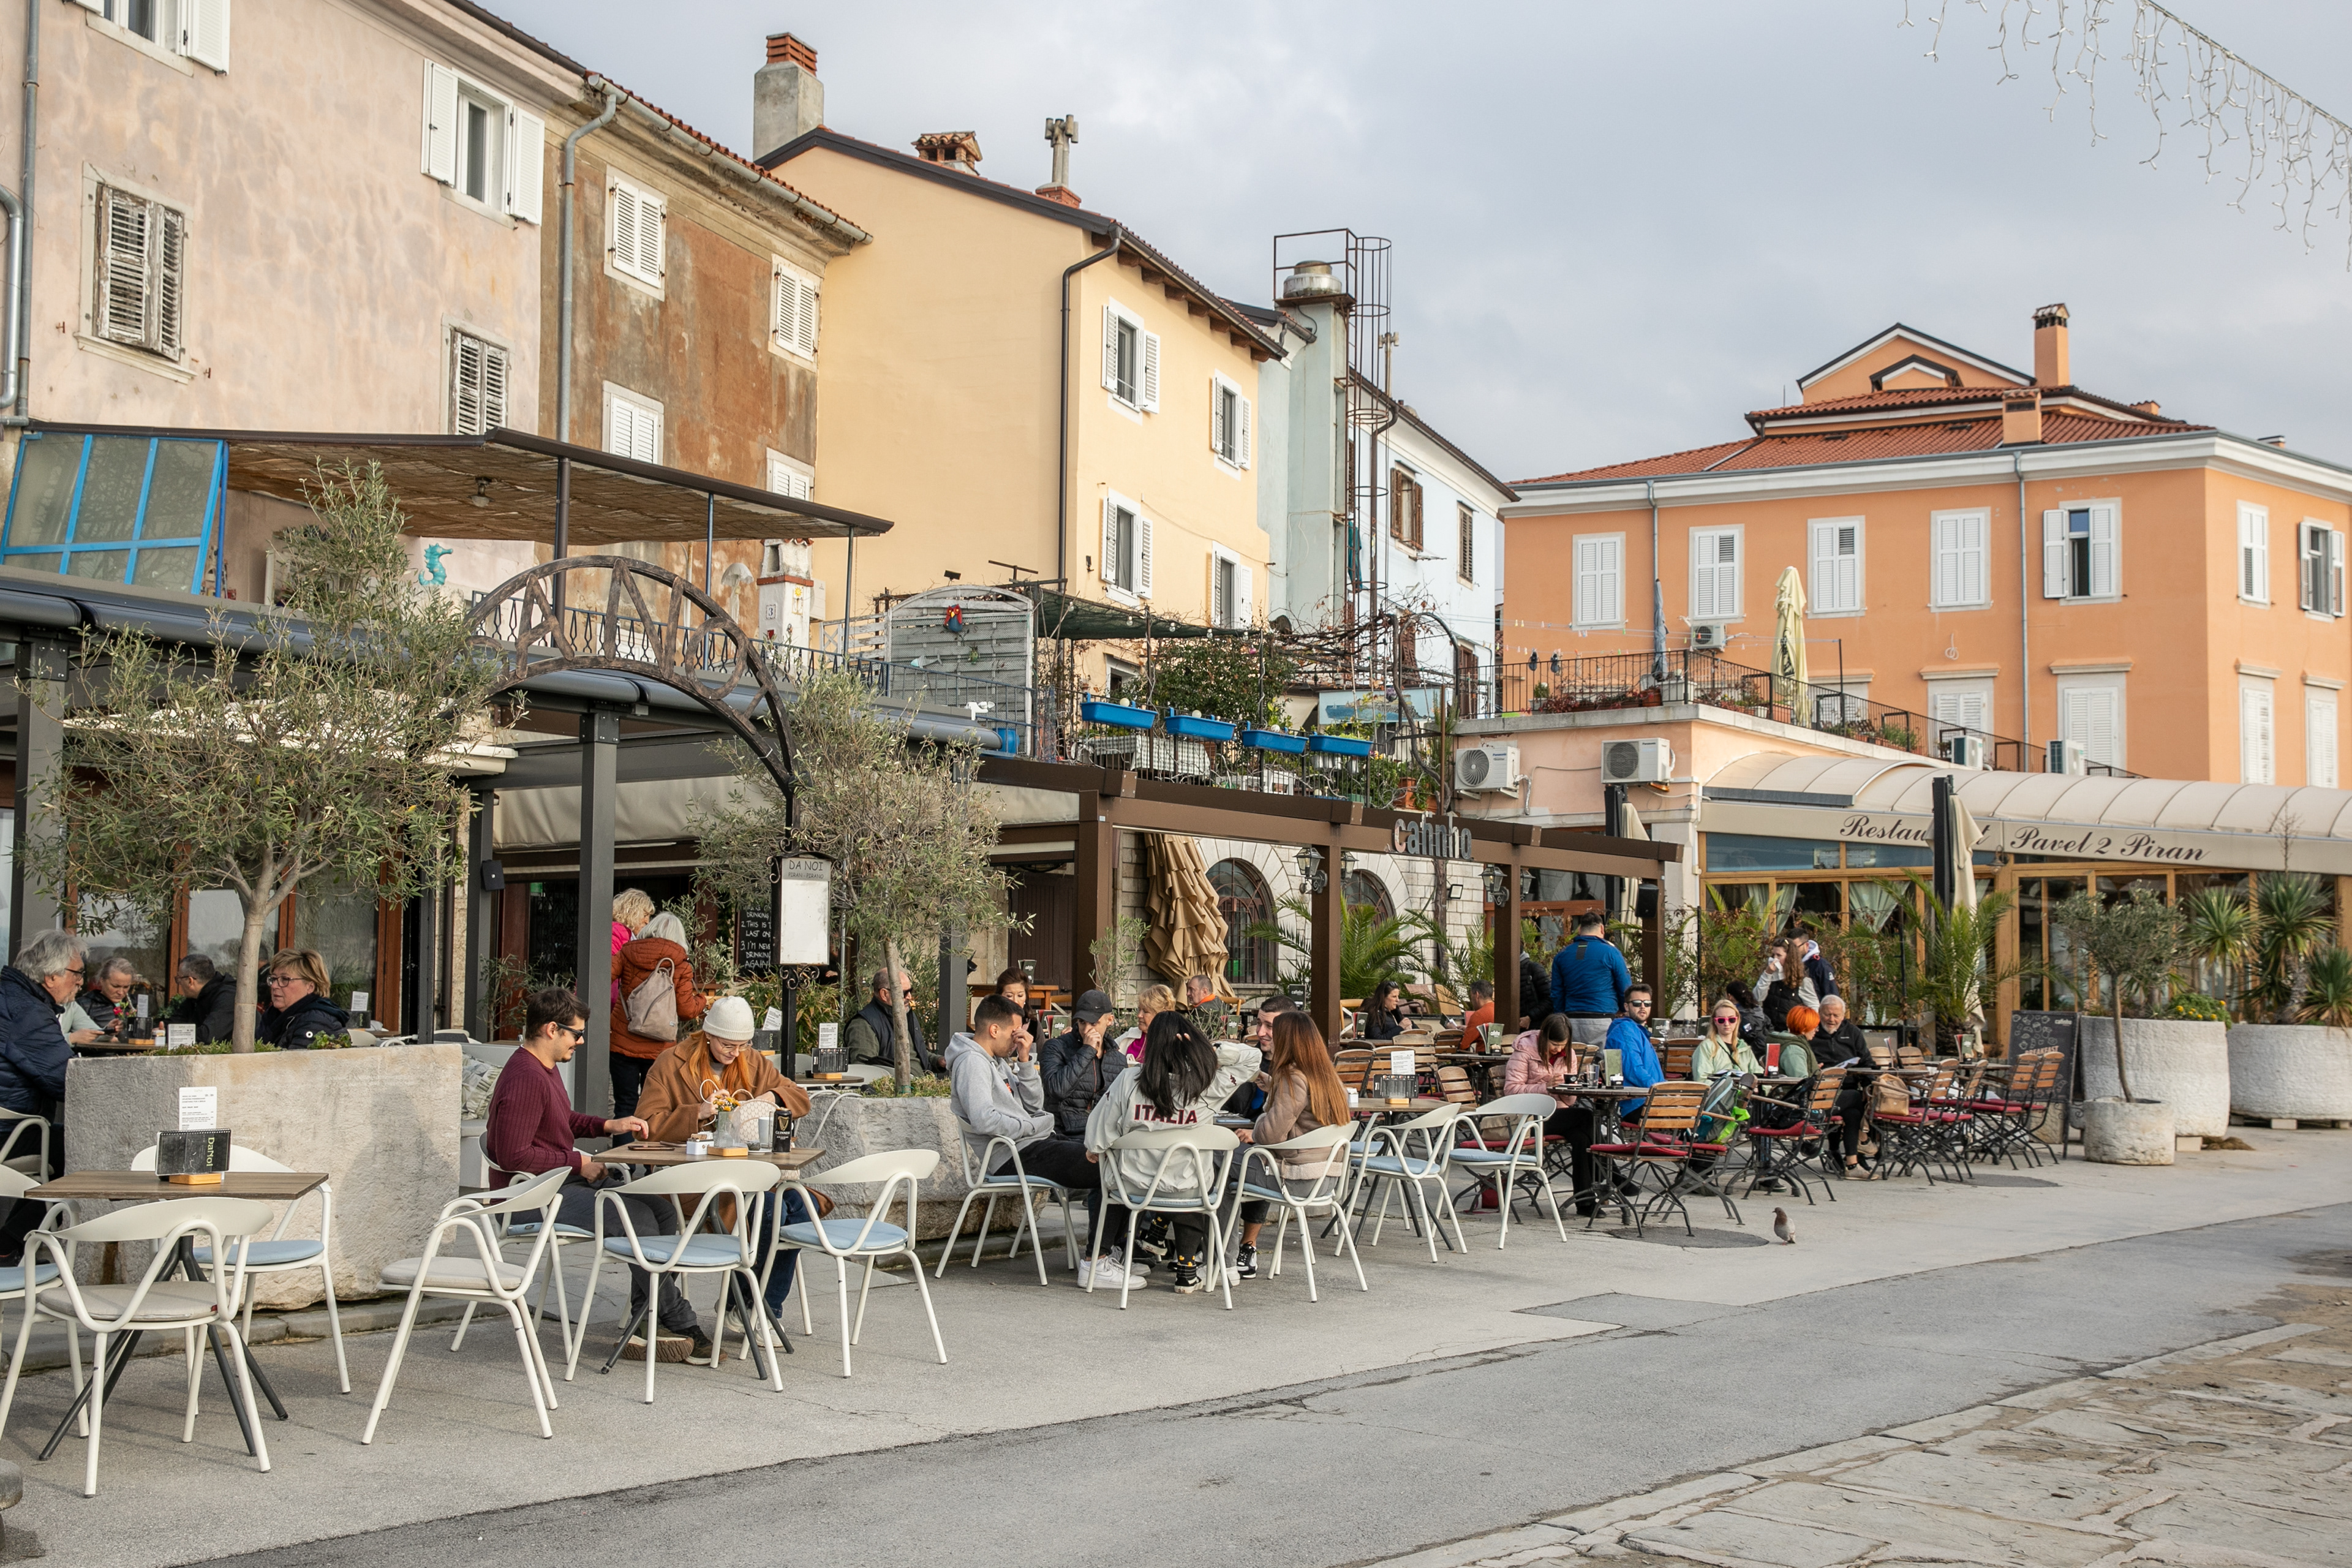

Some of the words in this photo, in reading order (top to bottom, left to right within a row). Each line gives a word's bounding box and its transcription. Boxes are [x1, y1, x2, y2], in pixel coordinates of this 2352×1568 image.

[768, 607, 774, 616] 3
[604, 558, 778, 735] NOI
[1394, 810, 1472, 860] cafinho
[2010, 826, 2094, 853] Pavel
[2094, 837, 2112, 854] 2
[2120, 832, 2212, 861] Piran
[789, 859, 802, 870] DA
[804, 861, 823, 871] NOI
[746, 911, 769, 921] DRINKING
[206, 1137, 215, 1167] DaNoi
